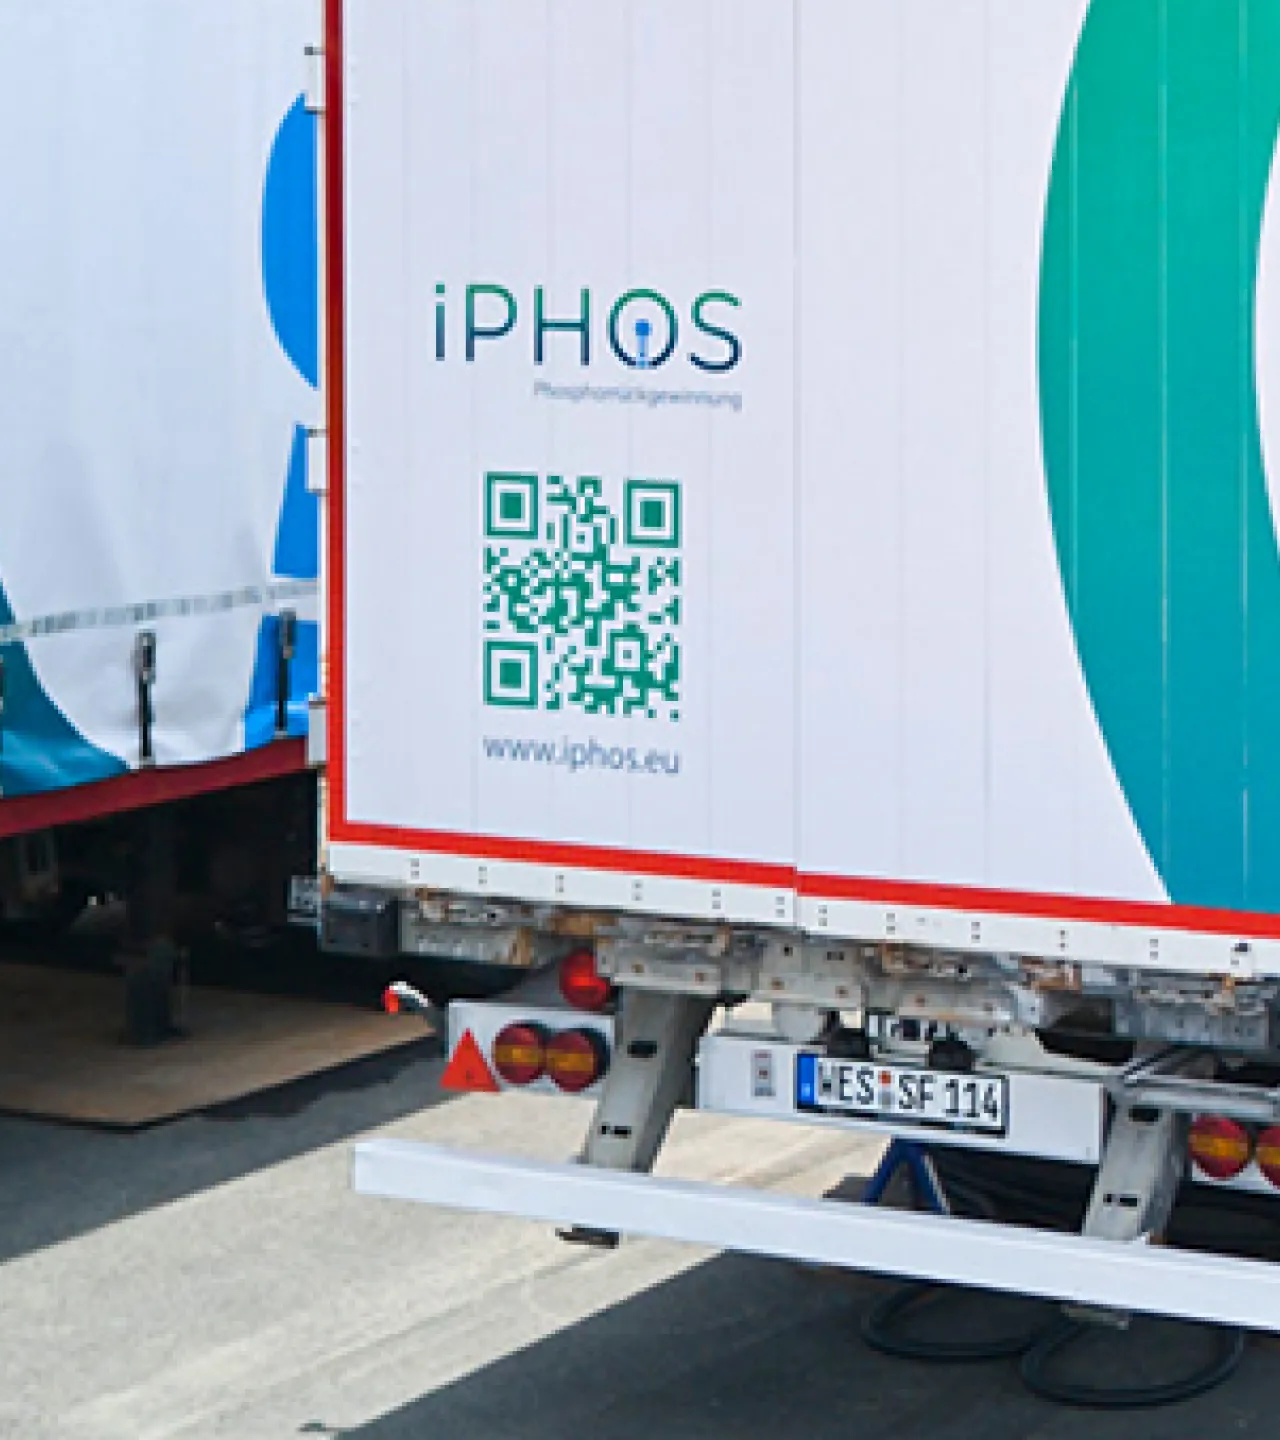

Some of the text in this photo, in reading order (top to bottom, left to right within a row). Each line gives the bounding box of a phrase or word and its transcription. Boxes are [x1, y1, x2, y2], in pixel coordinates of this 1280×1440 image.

[434, 282, 744, 373] iPHOS
[482, 736, 681, 775] www.iphos.eu
[819, 1062, 875, 1106] WES
[898, 1073, 935, 1111] SF
[945, 1078, 999, 1122] 114
